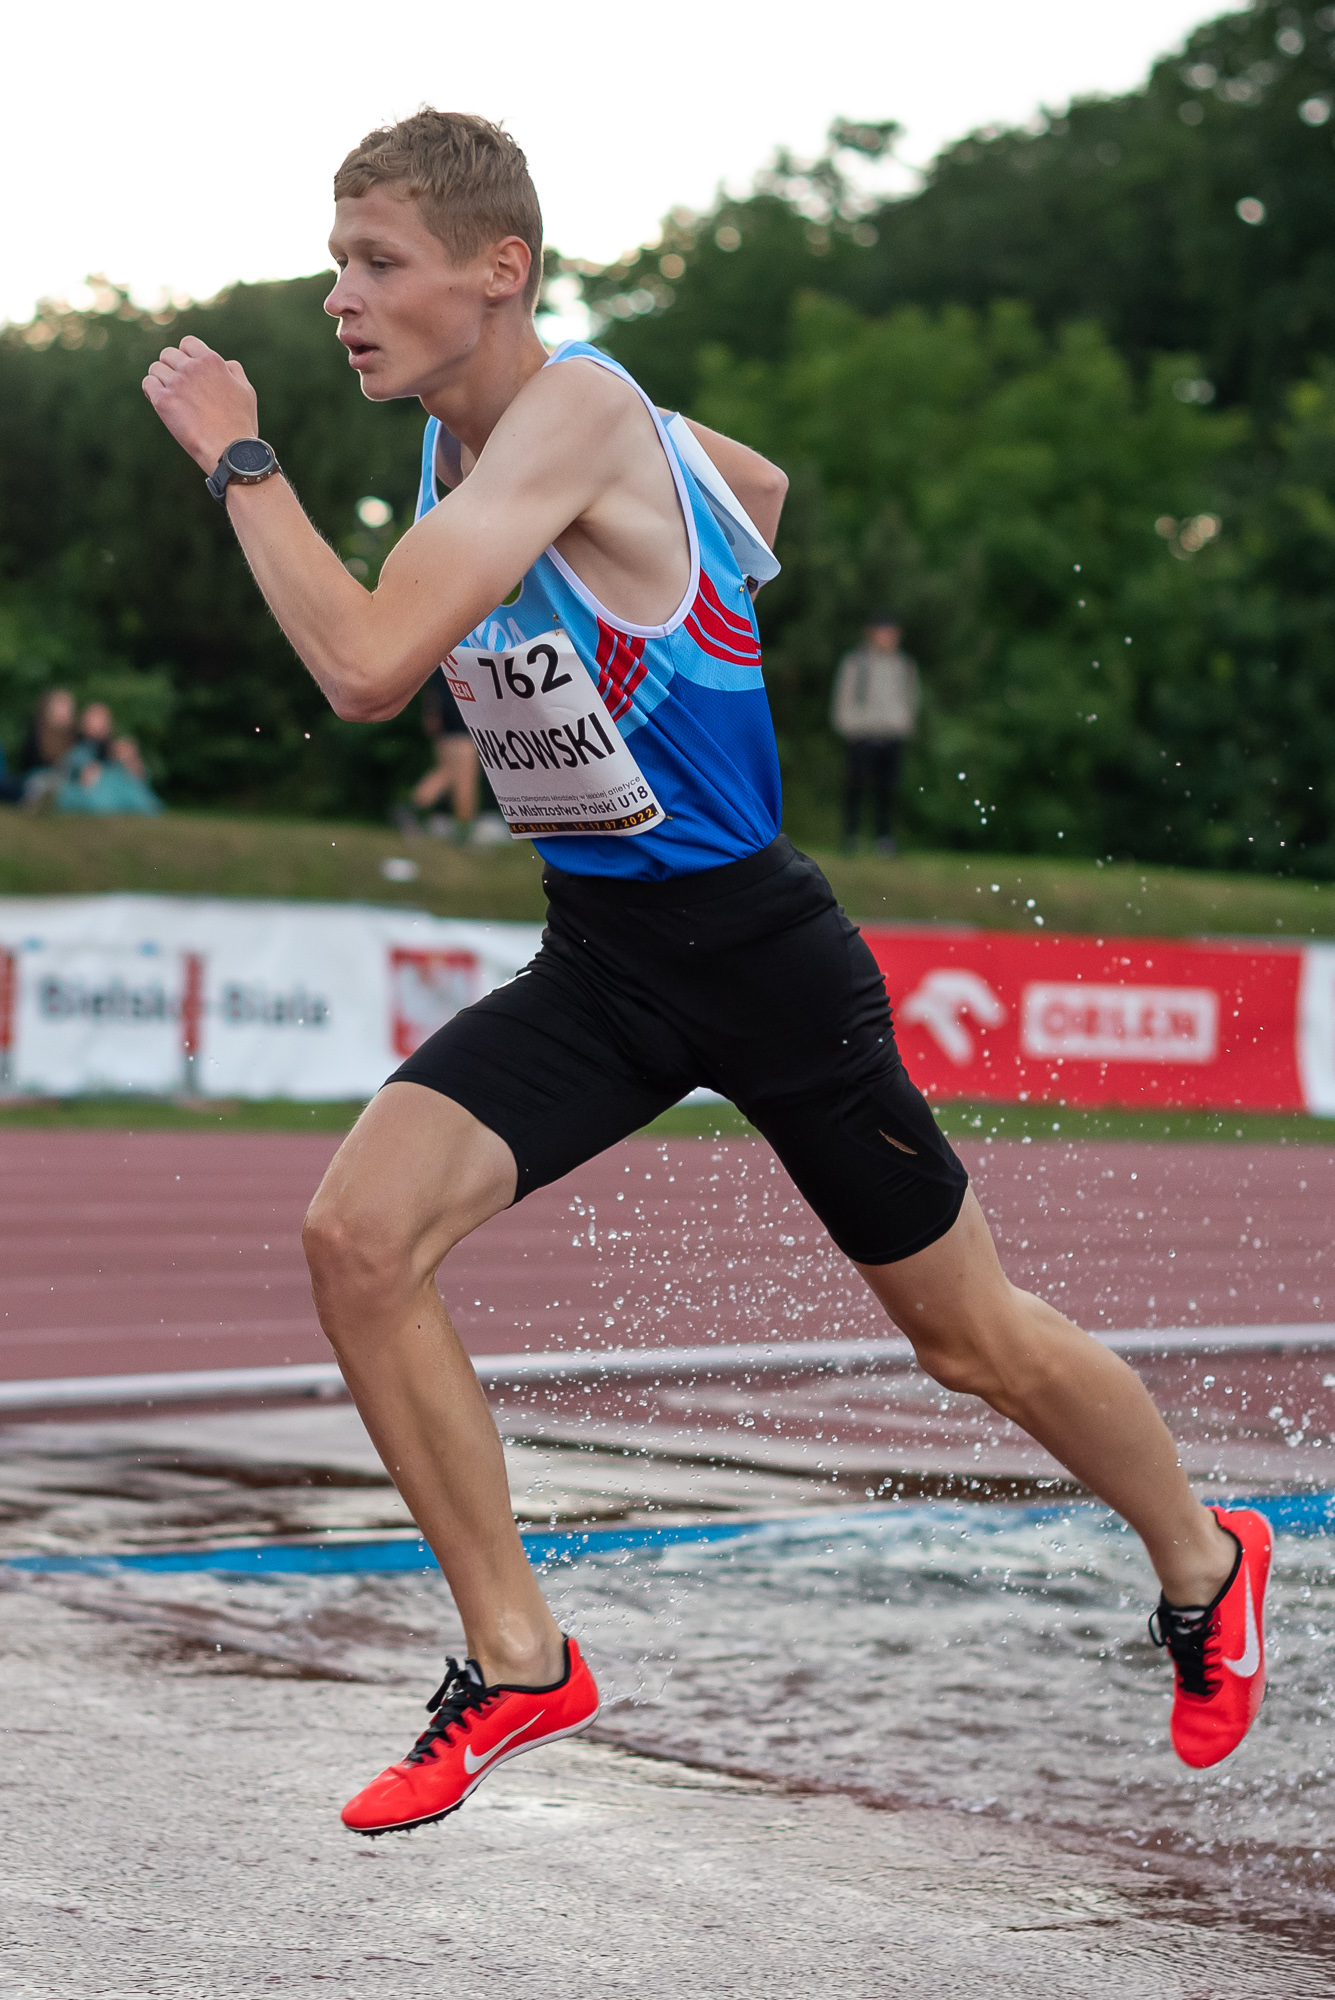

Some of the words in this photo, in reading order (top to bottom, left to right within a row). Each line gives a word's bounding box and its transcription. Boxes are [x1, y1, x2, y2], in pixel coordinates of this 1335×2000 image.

[476, 643, 573, 700] 762
[469, 711, 616, 770] WŁOWSKI
[499, 803, 519, 817] ZLA
[517, 803, 582, 817] Mistrzostwa
[579, 799, 618, 815] Polski
[617, 785, 649, 809] U18
[607, 776, 641, 796] atletyce
